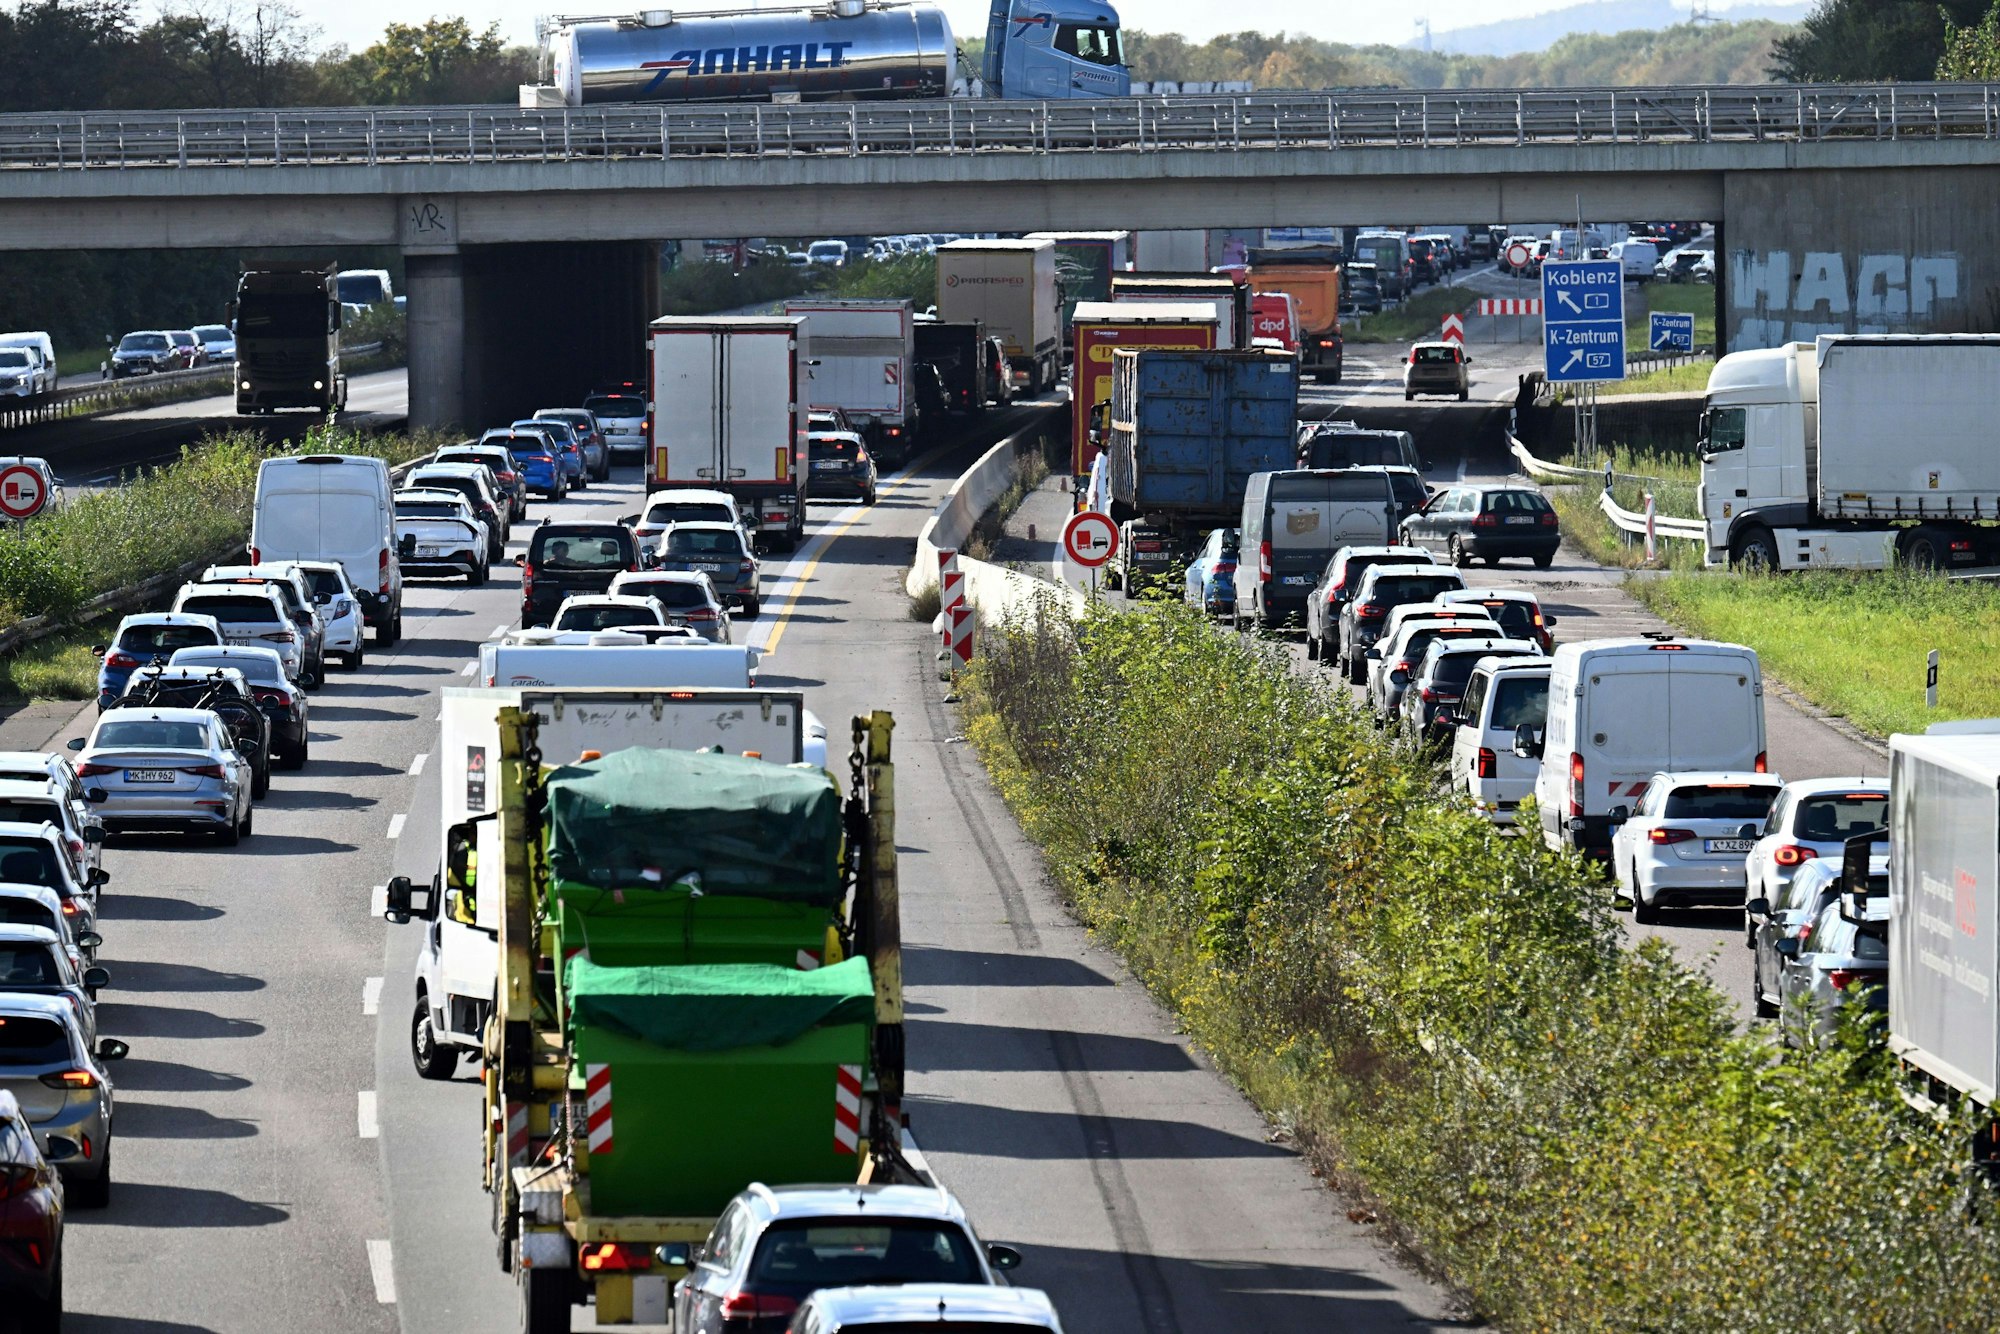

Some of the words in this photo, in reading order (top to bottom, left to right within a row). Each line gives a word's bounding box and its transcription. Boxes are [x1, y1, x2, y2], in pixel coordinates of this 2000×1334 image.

[1547, 270, 1617, 286] Koblenz
[1594, 296, 1599, 306] 1
[1259, 318, 1285, 334] dpd
[1653, 317, 1690, 328] K-Zentrum
[1550, 329, 1619, 345] K-Zentrum
[1592, 356, 1605, 365] 57
[511, 679, 545, 687] carado
[128, 769, 140, 781] MK
[145, 769, 157, 781] HY
[158, 769, 173, 781] 962
[1713, 840, 1720, 850] K
[1725, 840, 1737, 850] XZ
